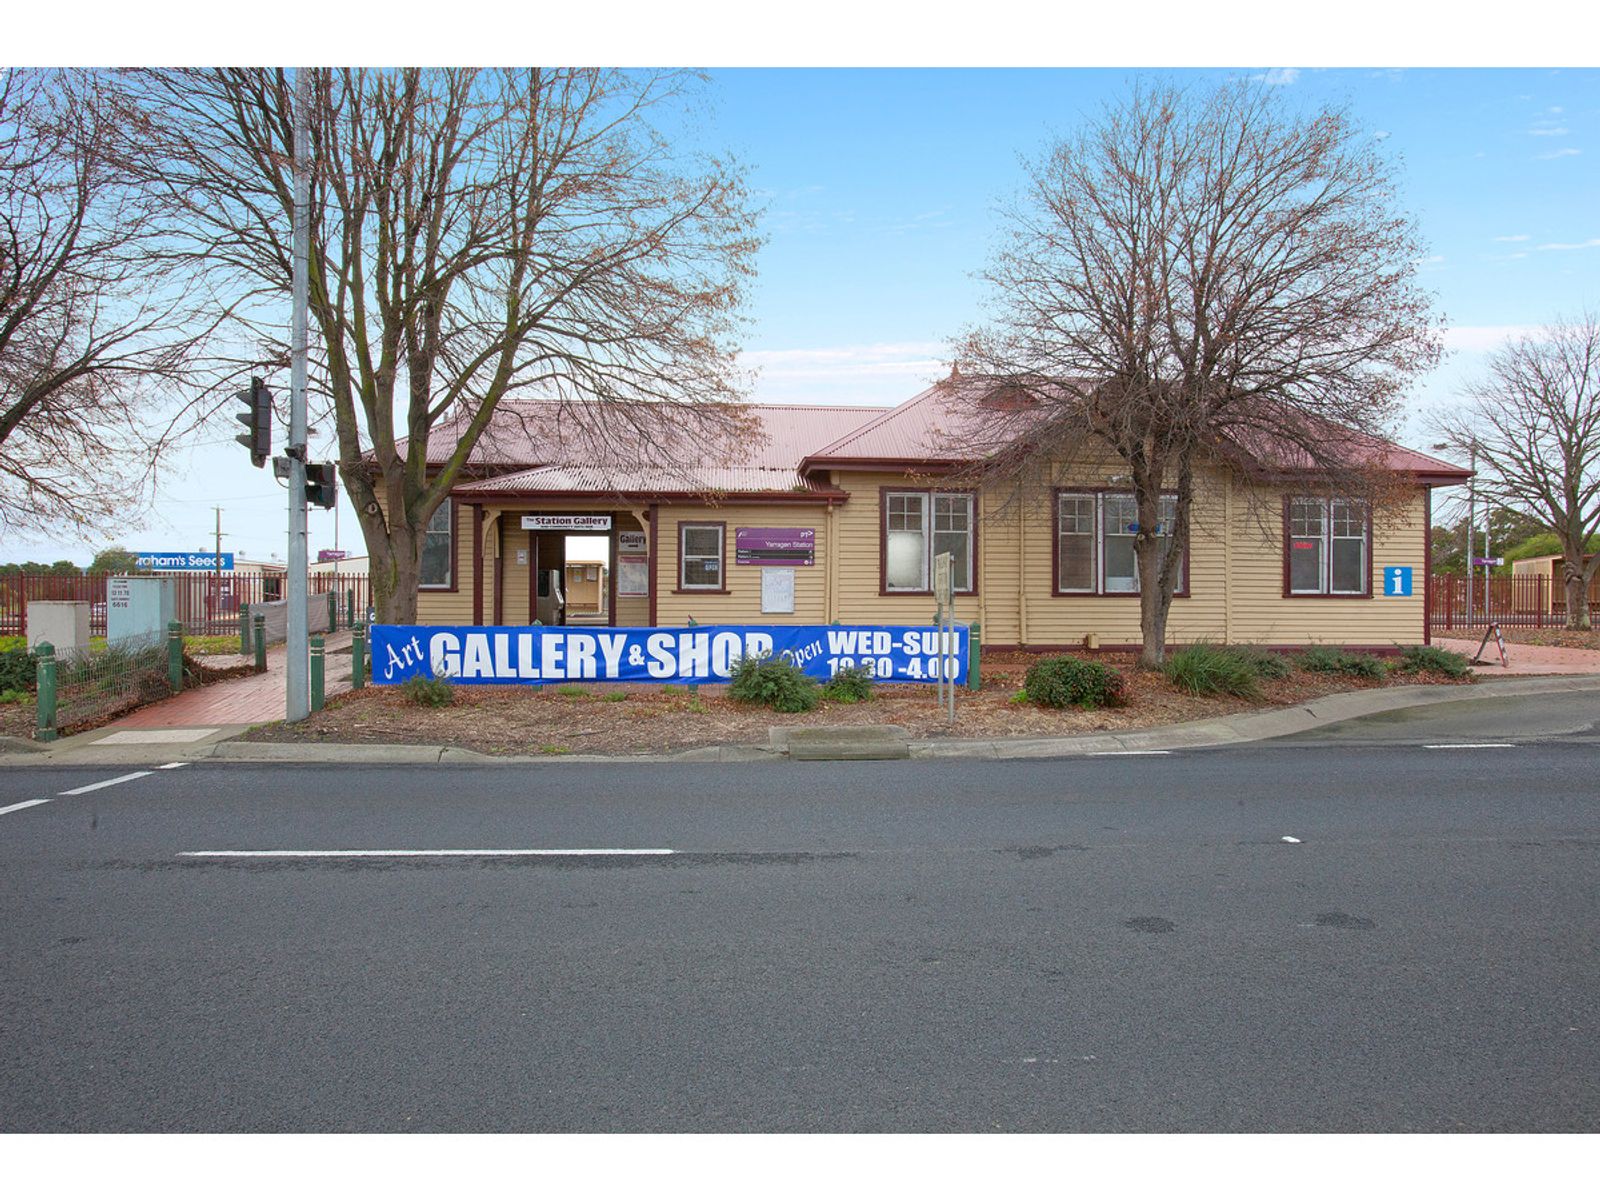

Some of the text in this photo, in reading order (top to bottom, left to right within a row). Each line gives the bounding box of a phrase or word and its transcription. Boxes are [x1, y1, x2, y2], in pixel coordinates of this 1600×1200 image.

[535, 517, 572, 525] Station
[573, 517, 608, 526] Gallery
[384, 636, 424, 679] Art
[430, 632, 628, 679] GALLERY
[628, 644, 646, 666] &
[646, 632, 773, 679] SHOP
